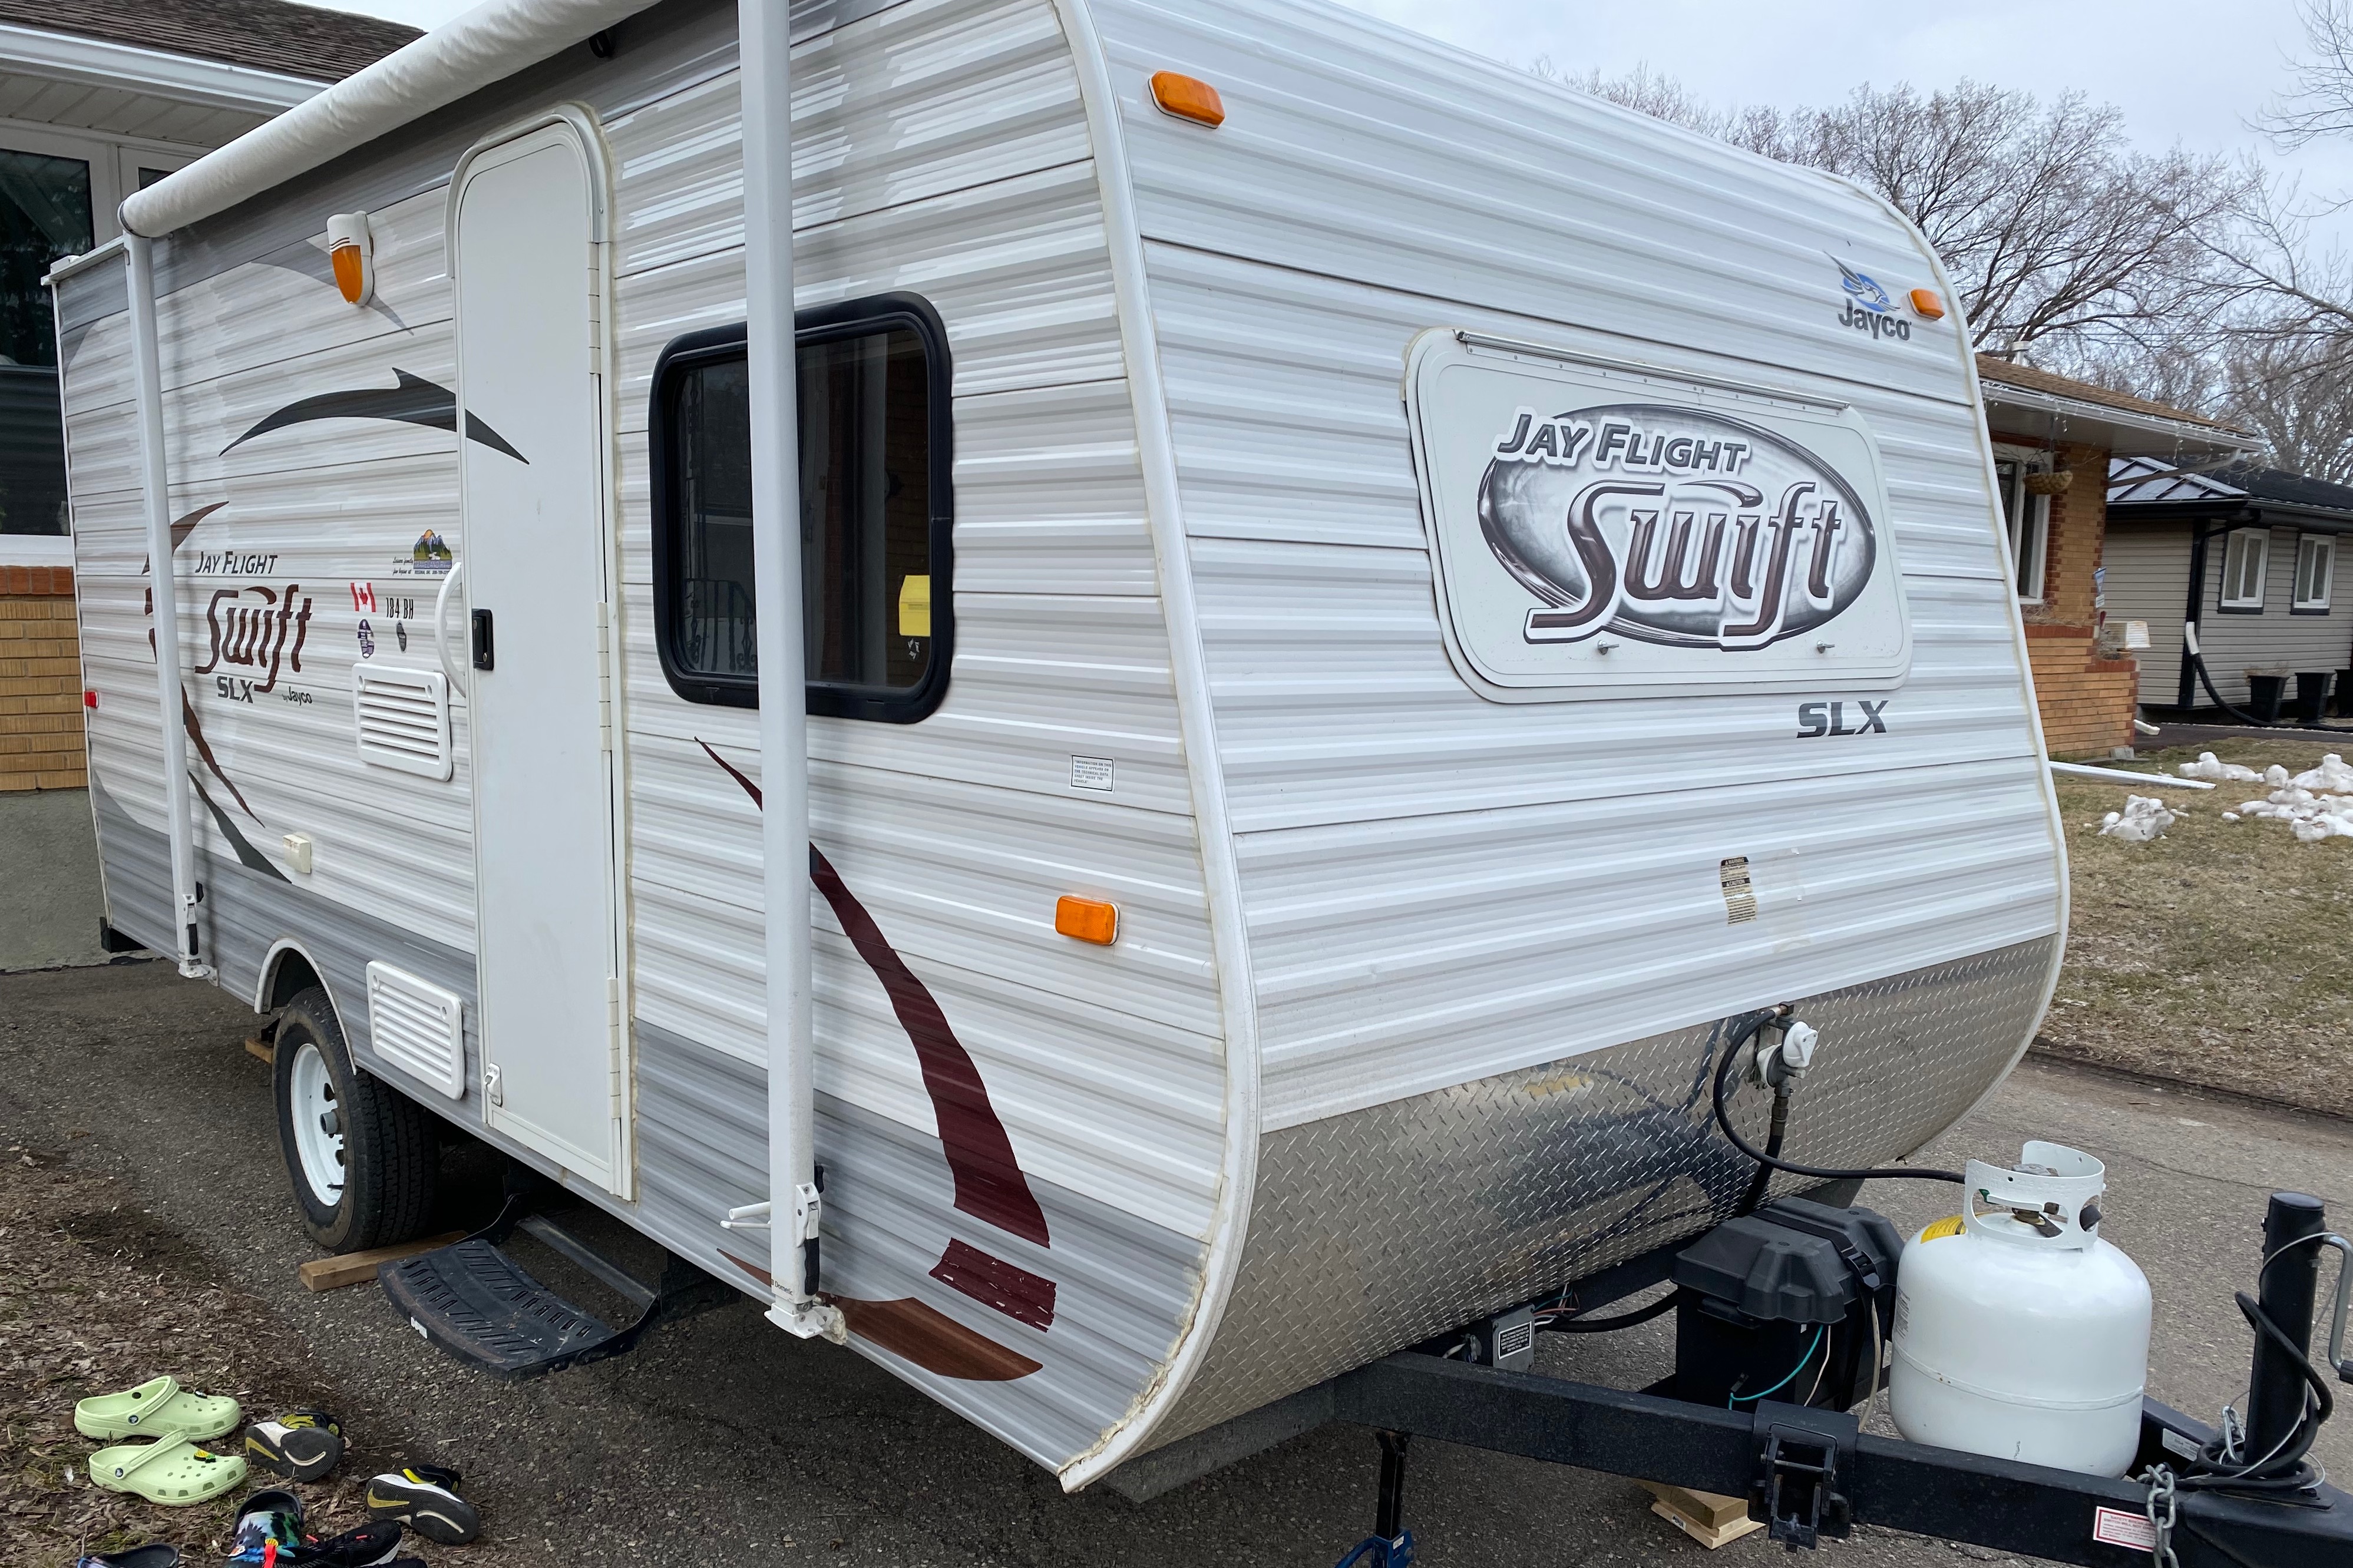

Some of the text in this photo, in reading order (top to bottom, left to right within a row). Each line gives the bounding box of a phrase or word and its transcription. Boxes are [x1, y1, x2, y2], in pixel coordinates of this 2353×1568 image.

[1838, 298, 1911, 341] Jayco
[1499, 414, 1748, 472] JAY FLIGHT
[194, 551, 278, 574] JAY FLIGHT
[1528, 479, 1842, 641] Swift
[386, 597, 414, 620] 184 BH
[194, 584, 313, 693] Swift
[216, 676, 253, 704] SLX
[287, 686, 312, 706] Jayco
[1796, 700, 1889, 739] SLX
